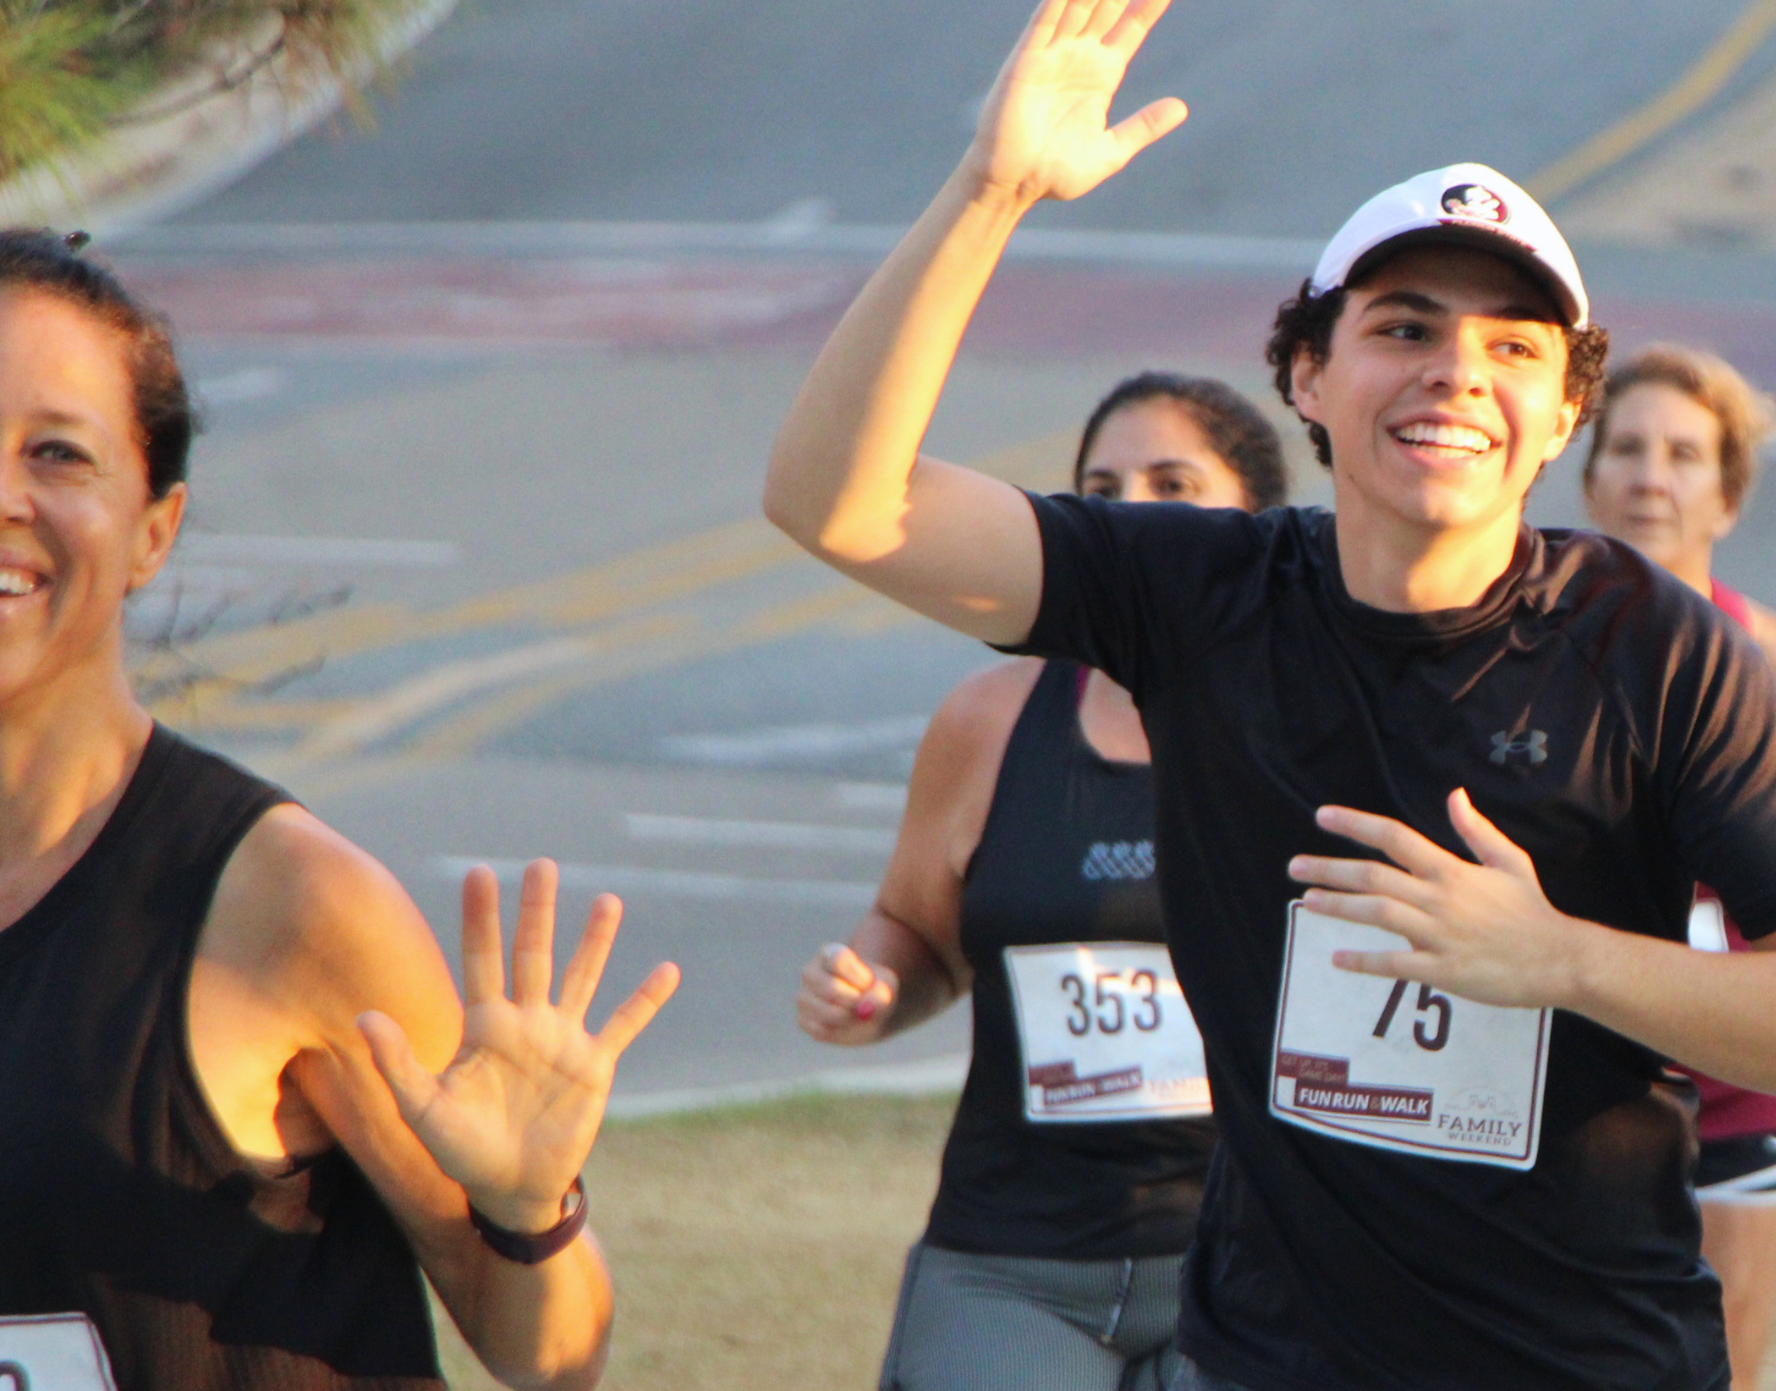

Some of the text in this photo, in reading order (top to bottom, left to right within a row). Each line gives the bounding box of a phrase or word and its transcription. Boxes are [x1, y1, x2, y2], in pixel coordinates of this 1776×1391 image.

[1060, 970, 1162, 1036] 353
[1371, 977, 1453, 1051] 75
[1380, 1095, 1430, 1115] WALK
[1437, 1113, 1523, 1138] FAMILY
[1448, 1131, 1512, 1147] WEEKEND
